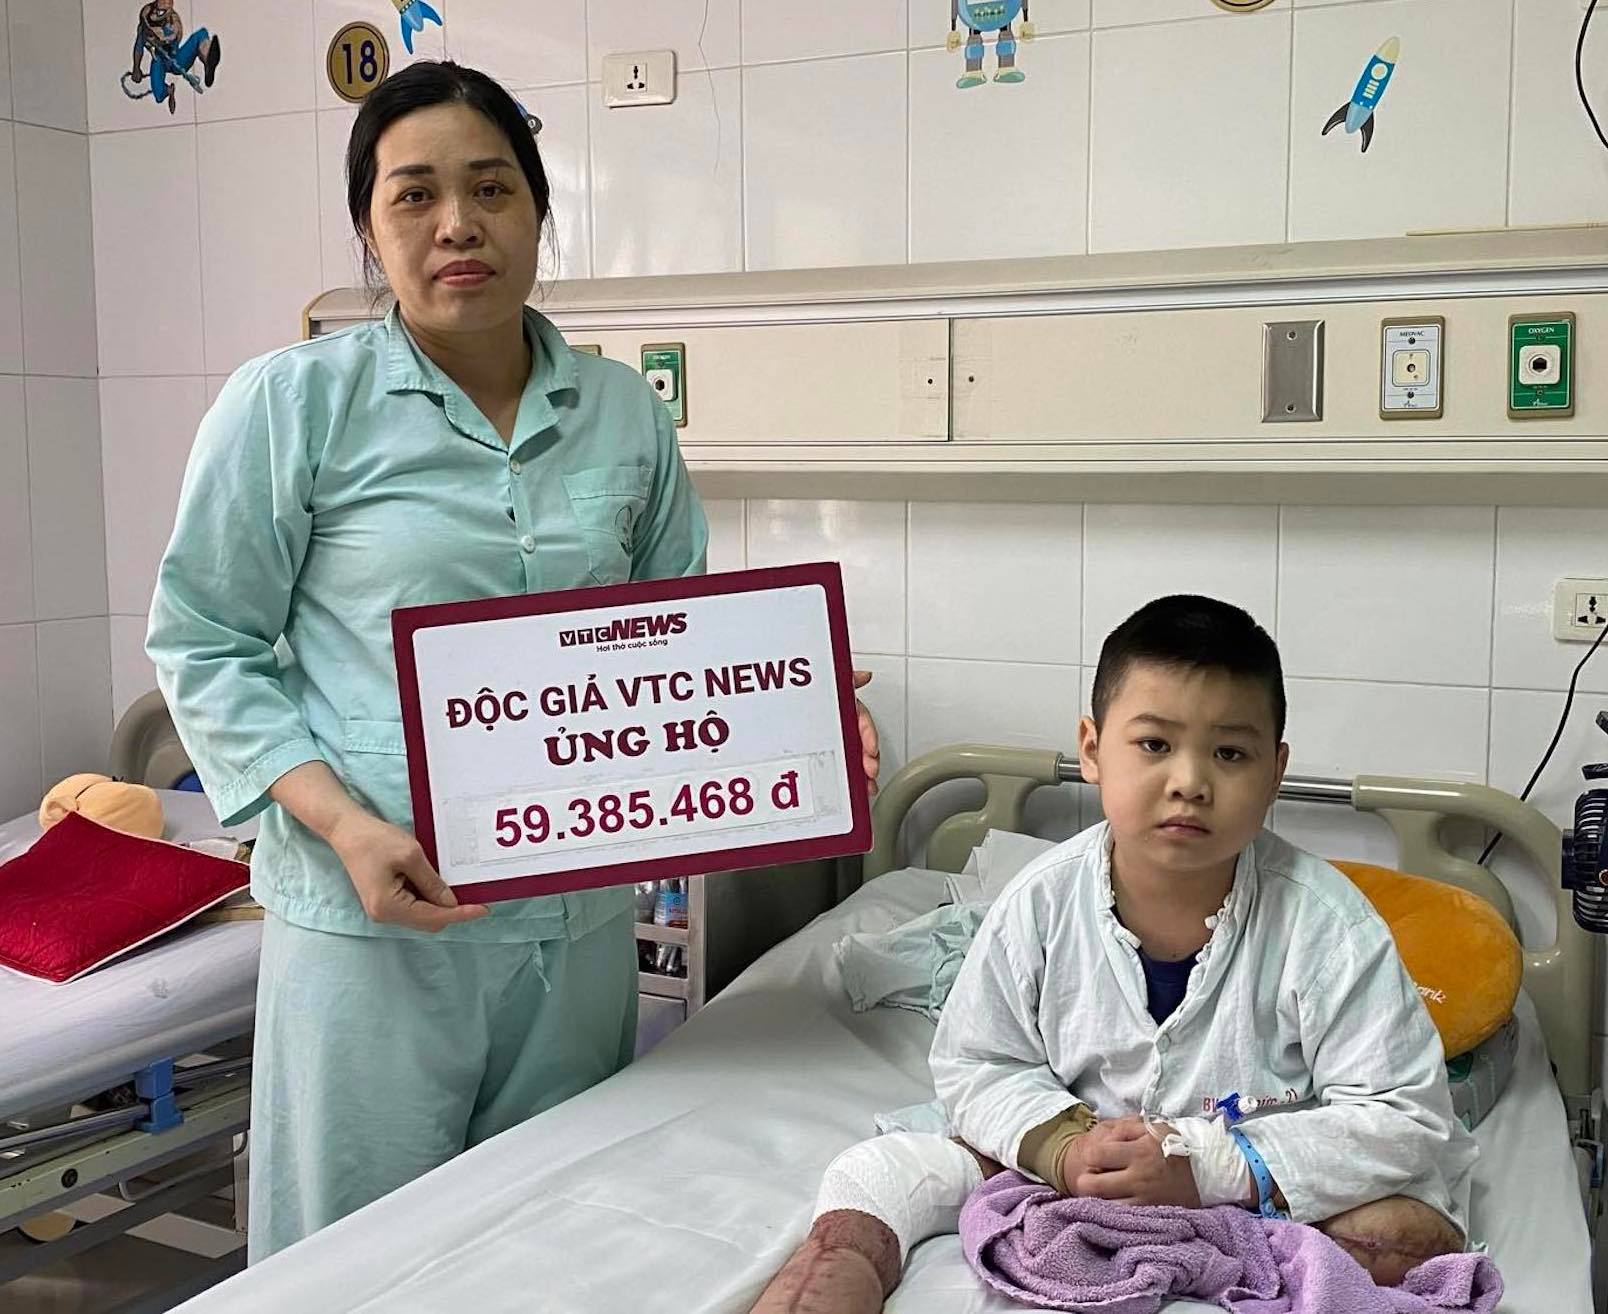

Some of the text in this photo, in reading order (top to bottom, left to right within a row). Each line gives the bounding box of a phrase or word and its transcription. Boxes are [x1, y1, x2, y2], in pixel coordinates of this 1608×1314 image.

[342, 39, 378, 84] 18
[446, 657, 813, 731] ĐỘC GIẢ VTC NEWS
[543, 710, 730, 766] ỦNG HỘ
[495, 770, 800, 847] 59.385.468 đ
